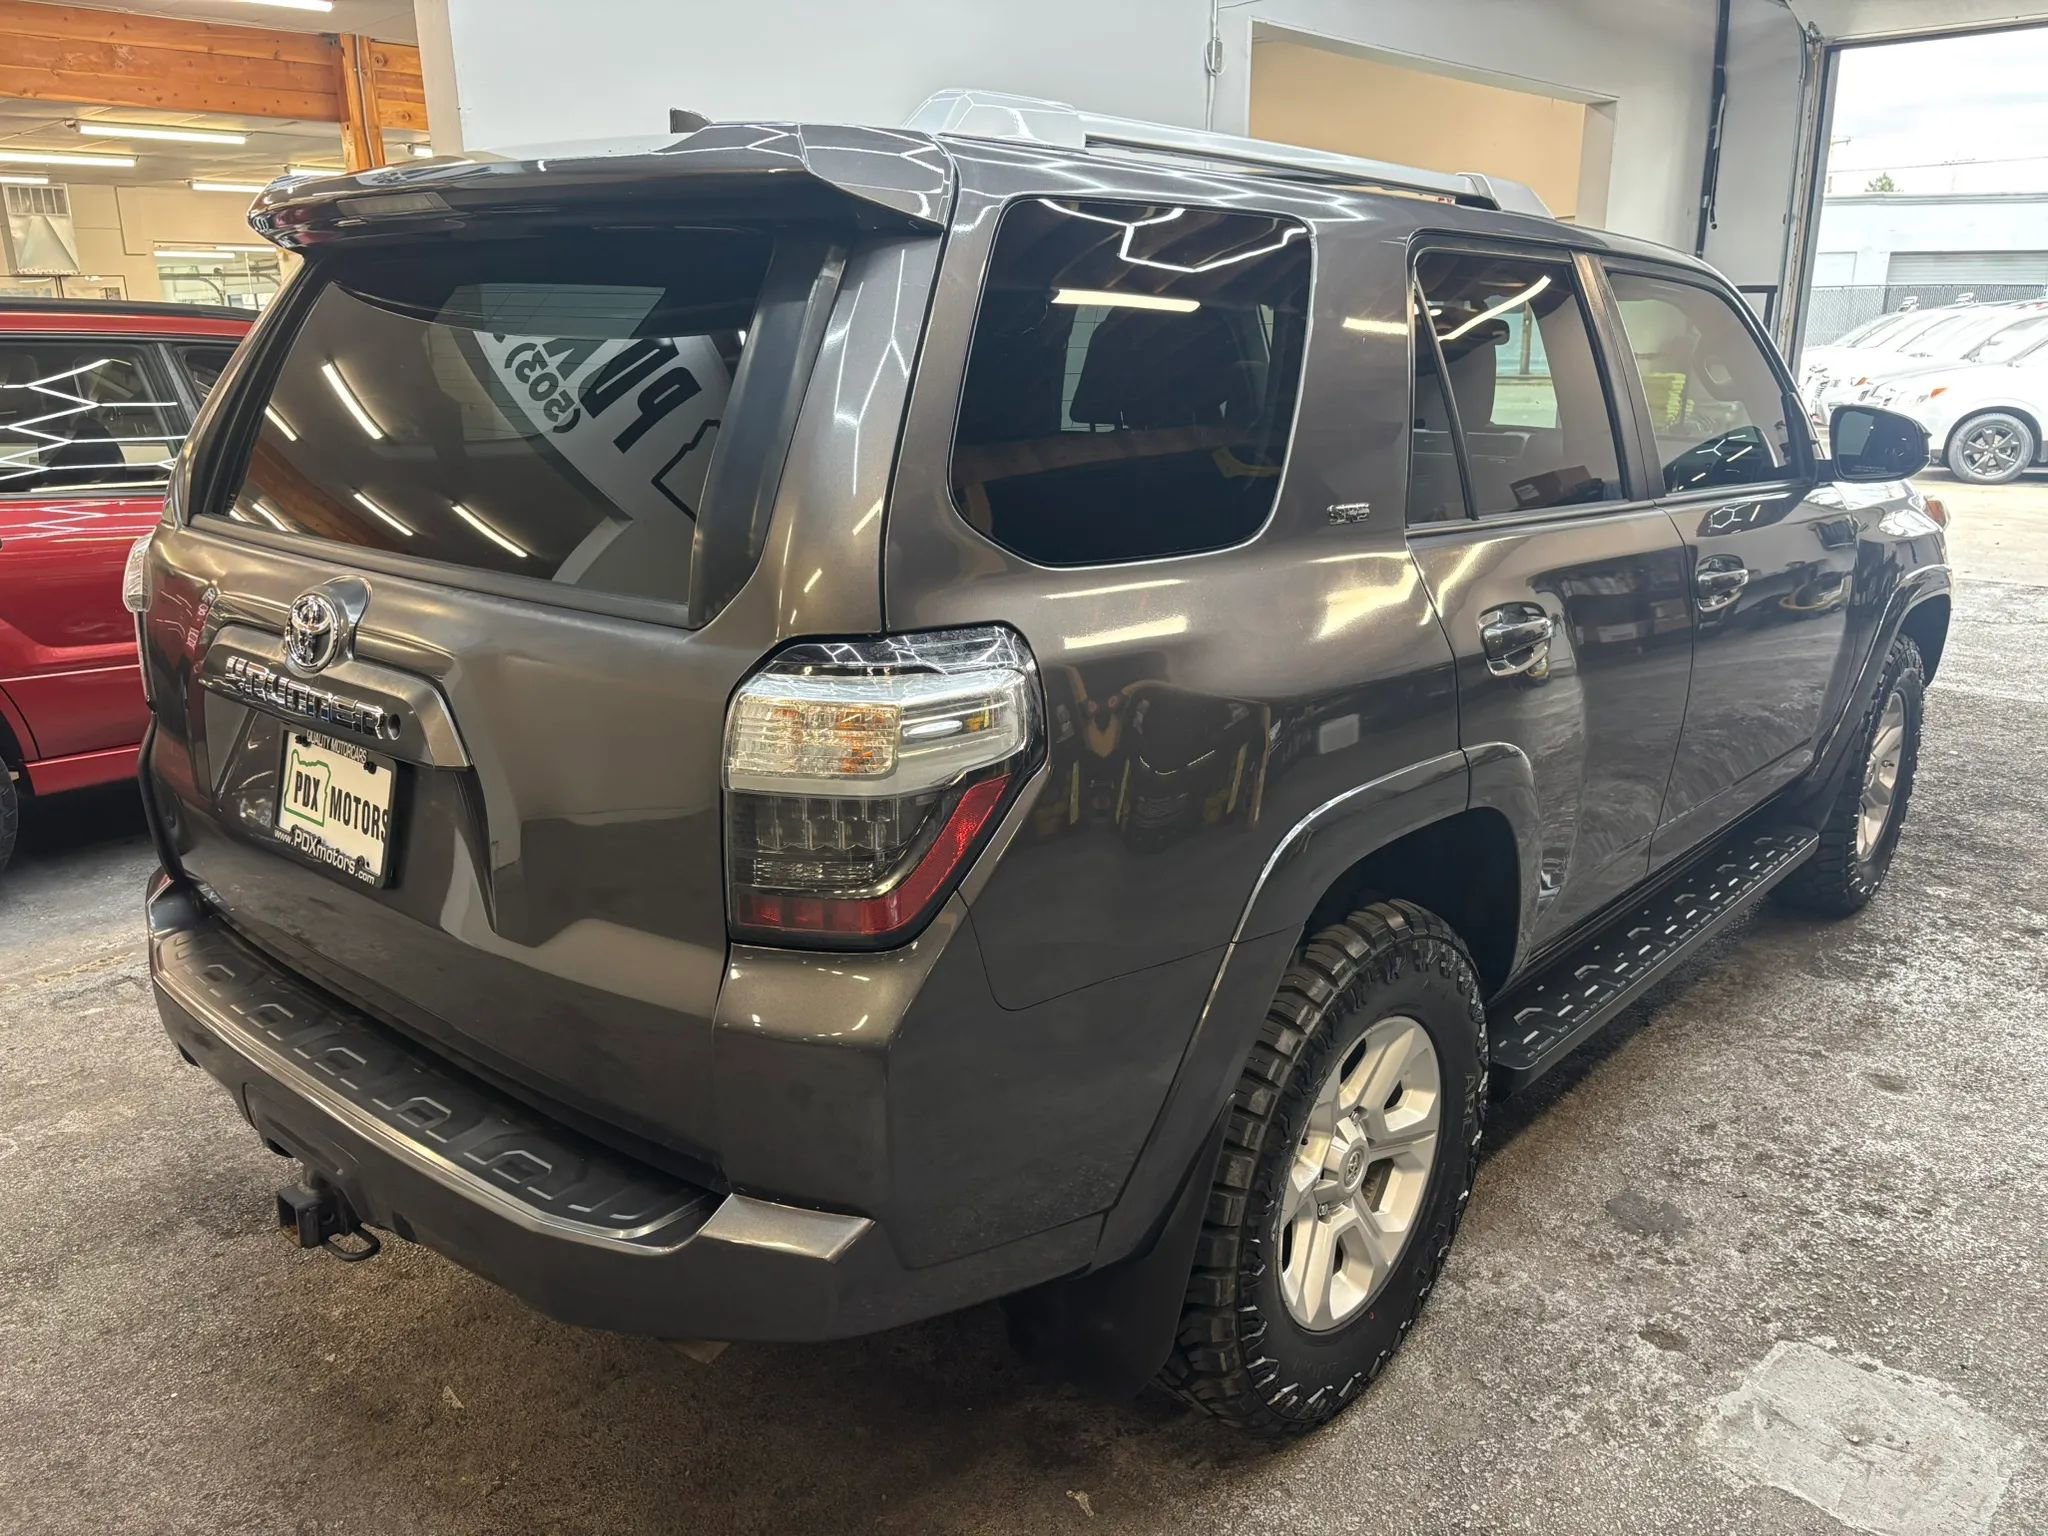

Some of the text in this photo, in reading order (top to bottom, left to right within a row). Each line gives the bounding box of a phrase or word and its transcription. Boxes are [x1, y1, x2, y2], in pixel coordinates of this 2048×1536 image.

[306, 730, 368, 764] QUALITY MOTORCARS
[293, 770, 389, 843] PDX MOTORS
[273, 829, 375, 885] www.PDXmotors.com
